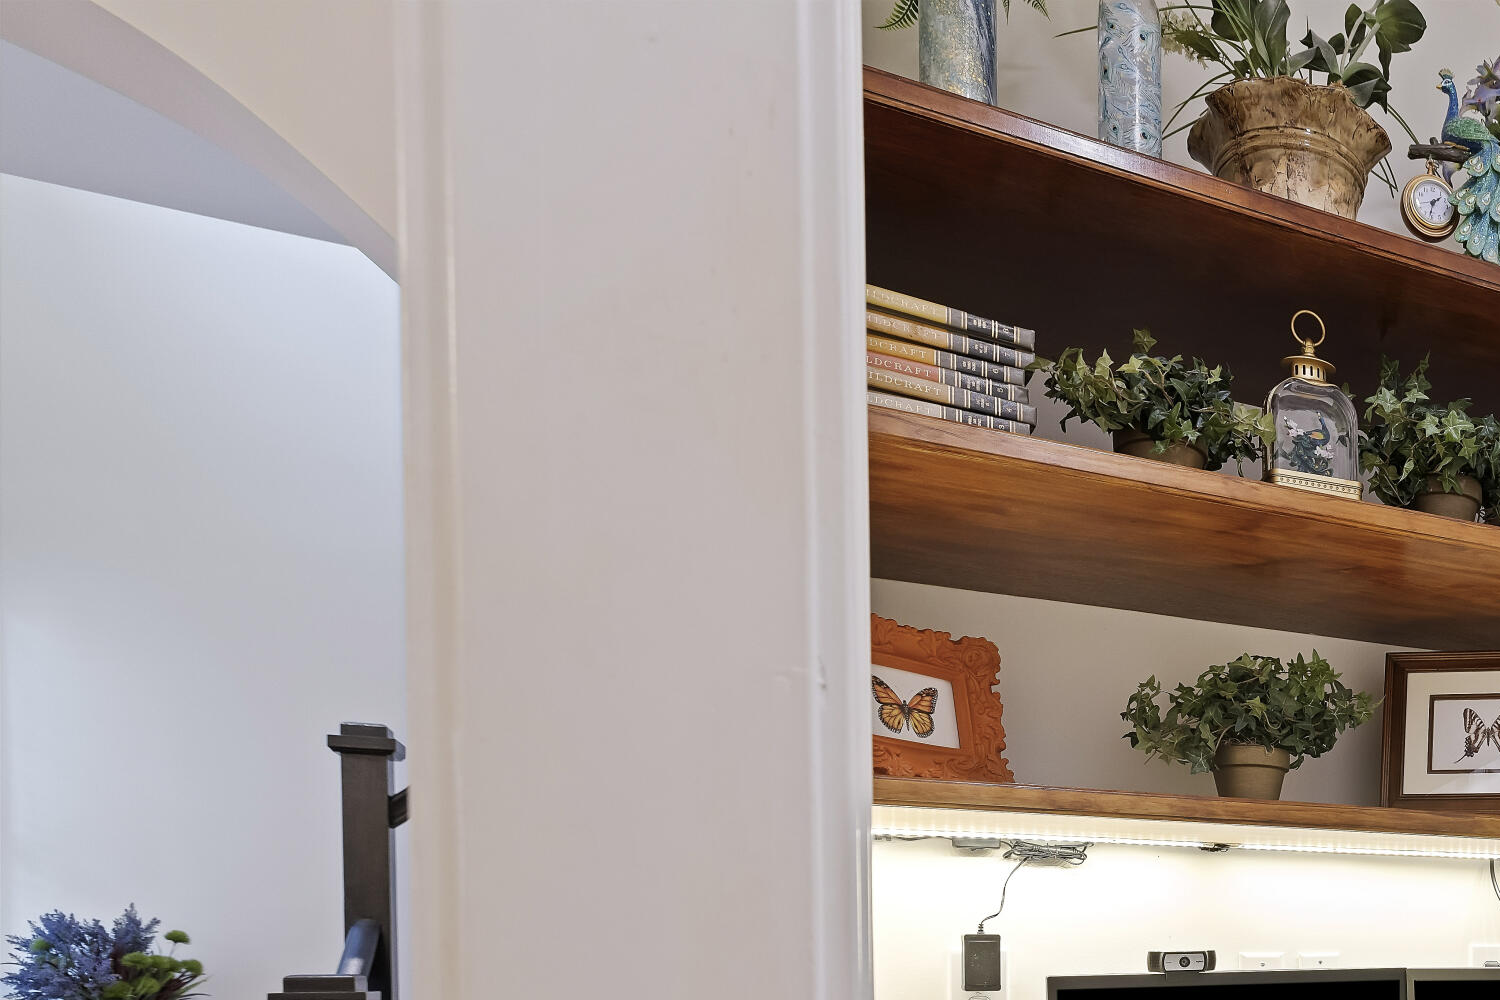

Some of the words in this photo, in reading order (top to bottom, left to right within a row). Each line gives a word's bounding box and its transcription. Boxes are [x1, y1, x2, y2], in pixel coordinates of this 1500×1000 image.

[866, 288, 938, 316] ILDCRAFT
[867, 314, 939, 340] ILDCRAFT
[869, 338, 928, 360] DCRAFT
[866, 355, 933, 378] LDCRAFT
[868, 371, 943, 397] ILDCRAFT
[867, 393, 935, 416] LDCRAFT
